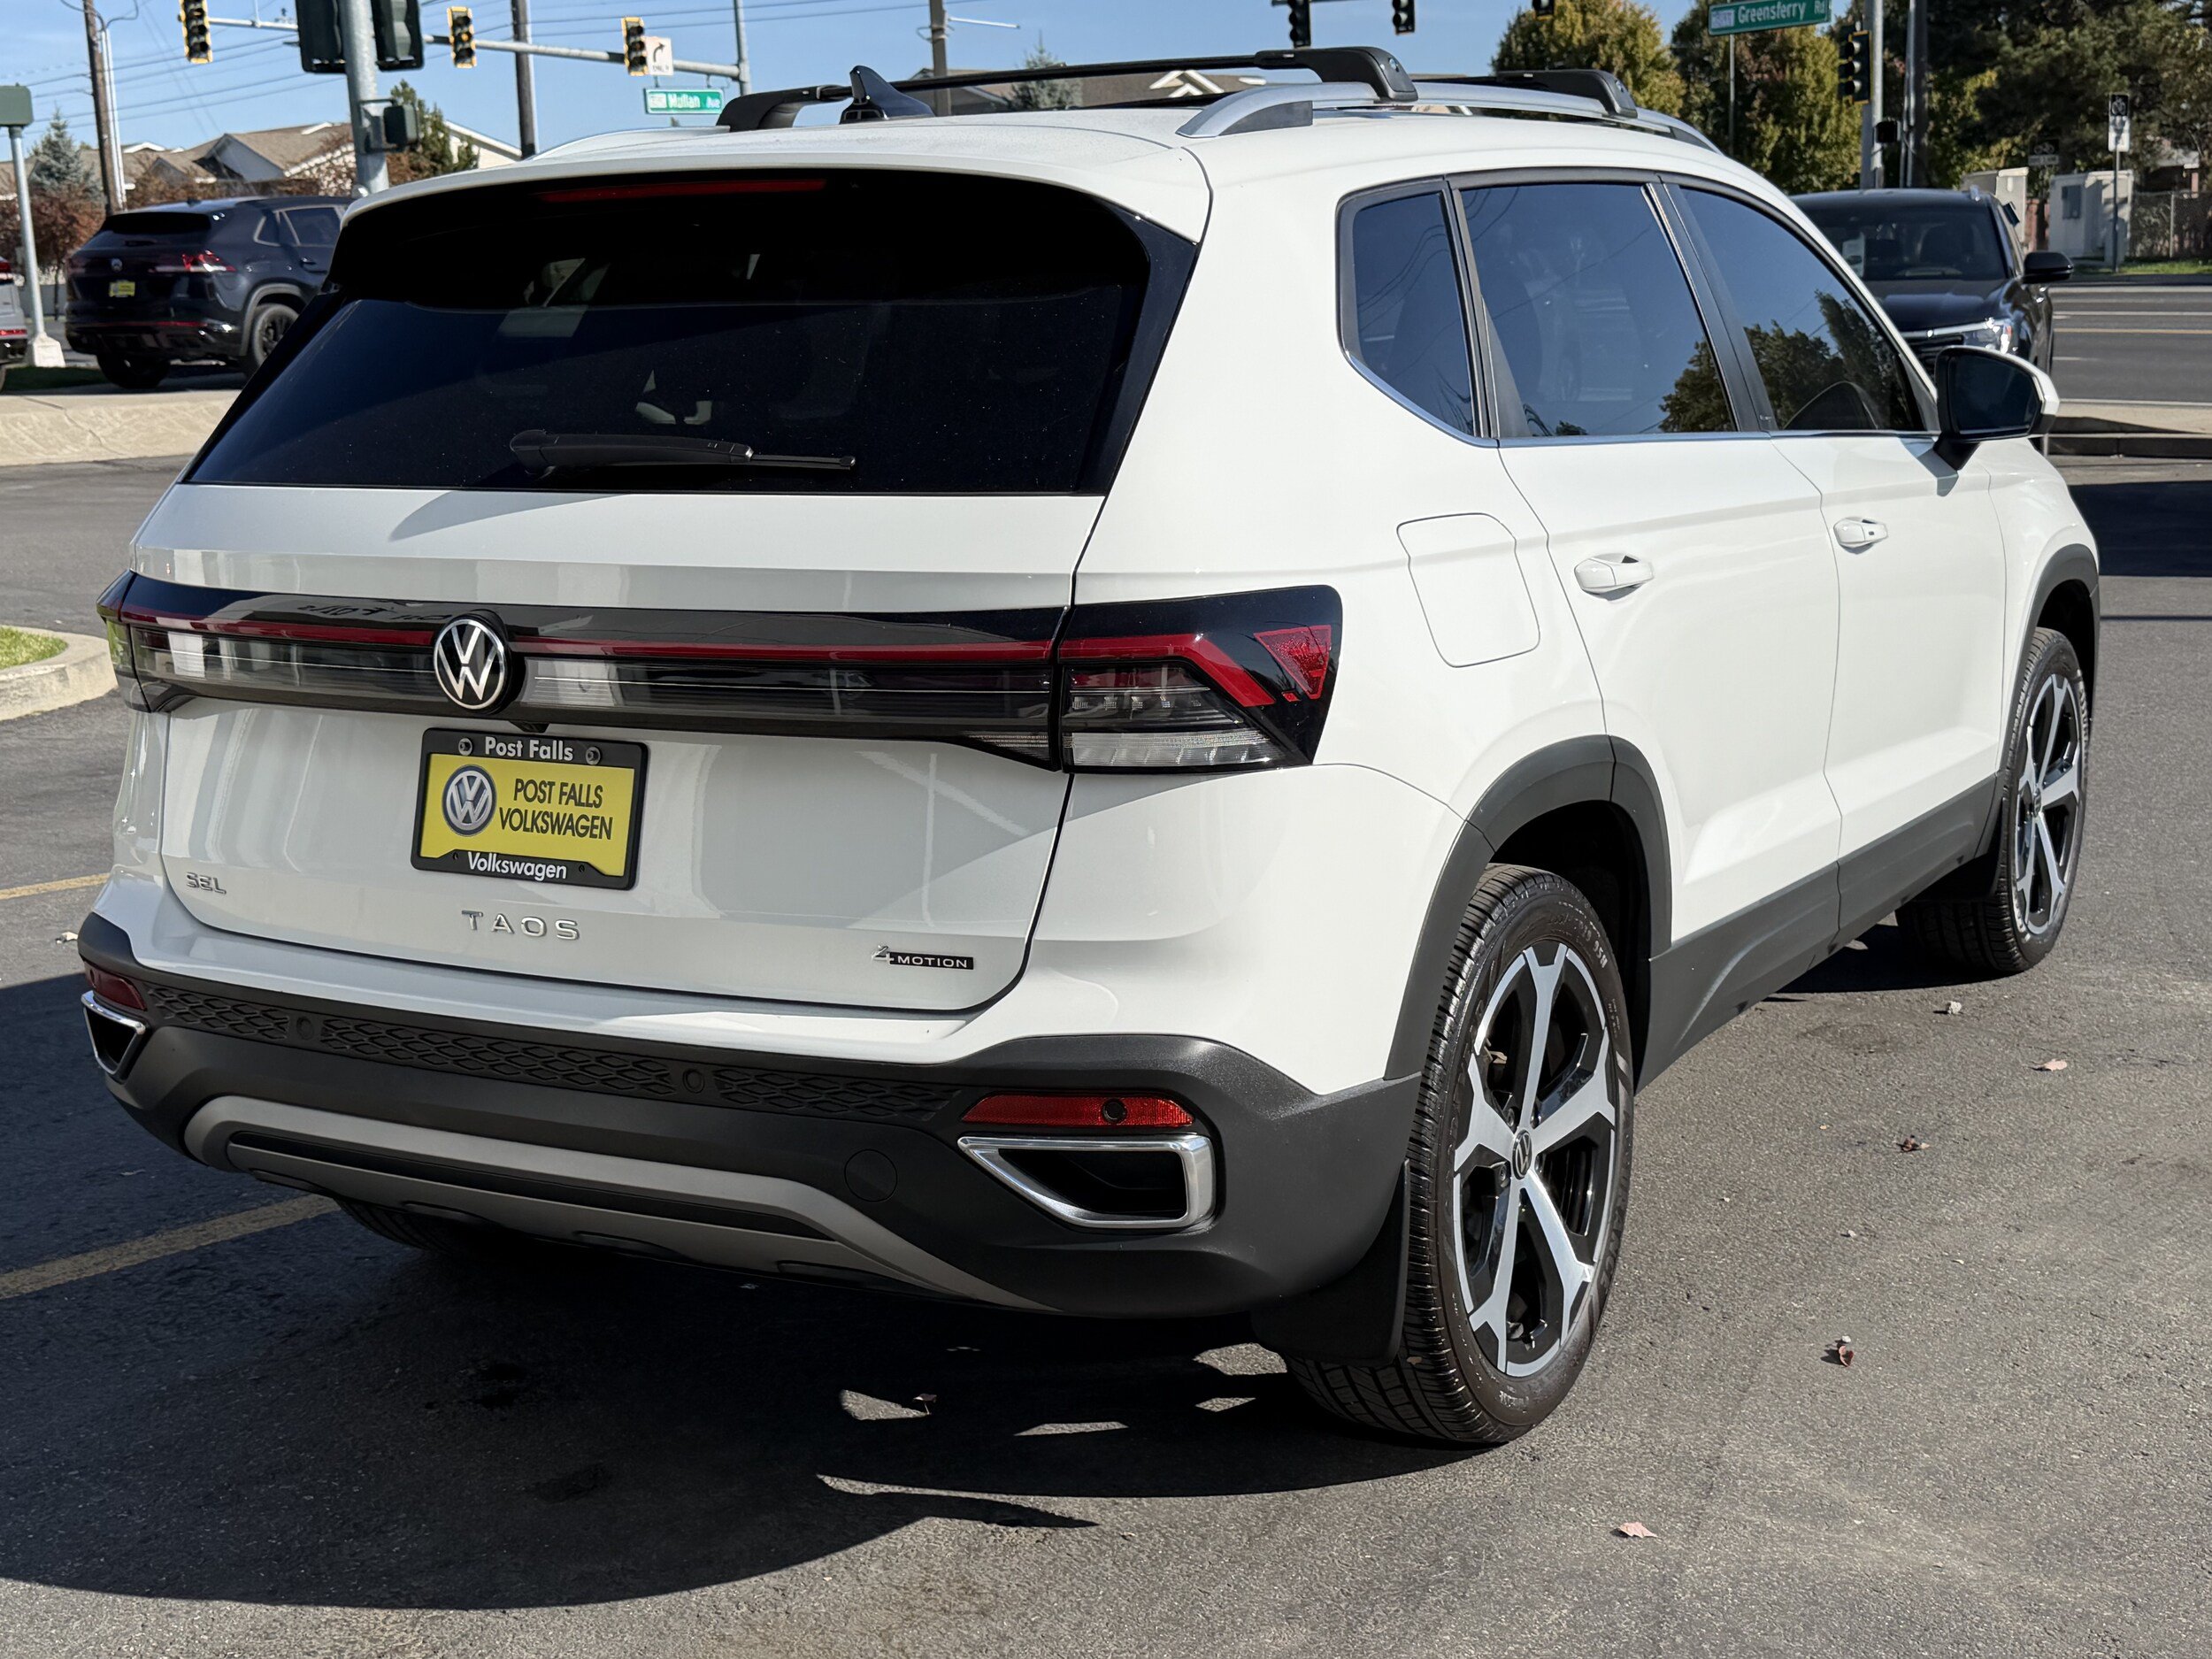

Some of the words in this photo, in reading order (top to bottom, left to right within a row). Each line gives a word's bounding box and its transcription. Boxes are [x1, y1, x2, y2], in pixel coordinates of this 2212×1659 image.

[1738, 1, 1806, 24] Greensferry
[1814, 0, 1826, 14] Rd
[667, 93, 700, 108] Mullan
[706, 96, 721, 108] Ave
[485, 736, 524, 757] Post
[529, 740, 573, 761] Falls
[514, 778, 557, 804] POST
[558, 781, 603, 809] FALLS
[499, 807, 613, 841] VOLKSWAGEN
[467, 851, 567, 881] Volkswagen
[186, 872, 227, 895] SEL
[461, 910, 580, 940] TAOS
[871, 944, 968, 969] 4MOTION
